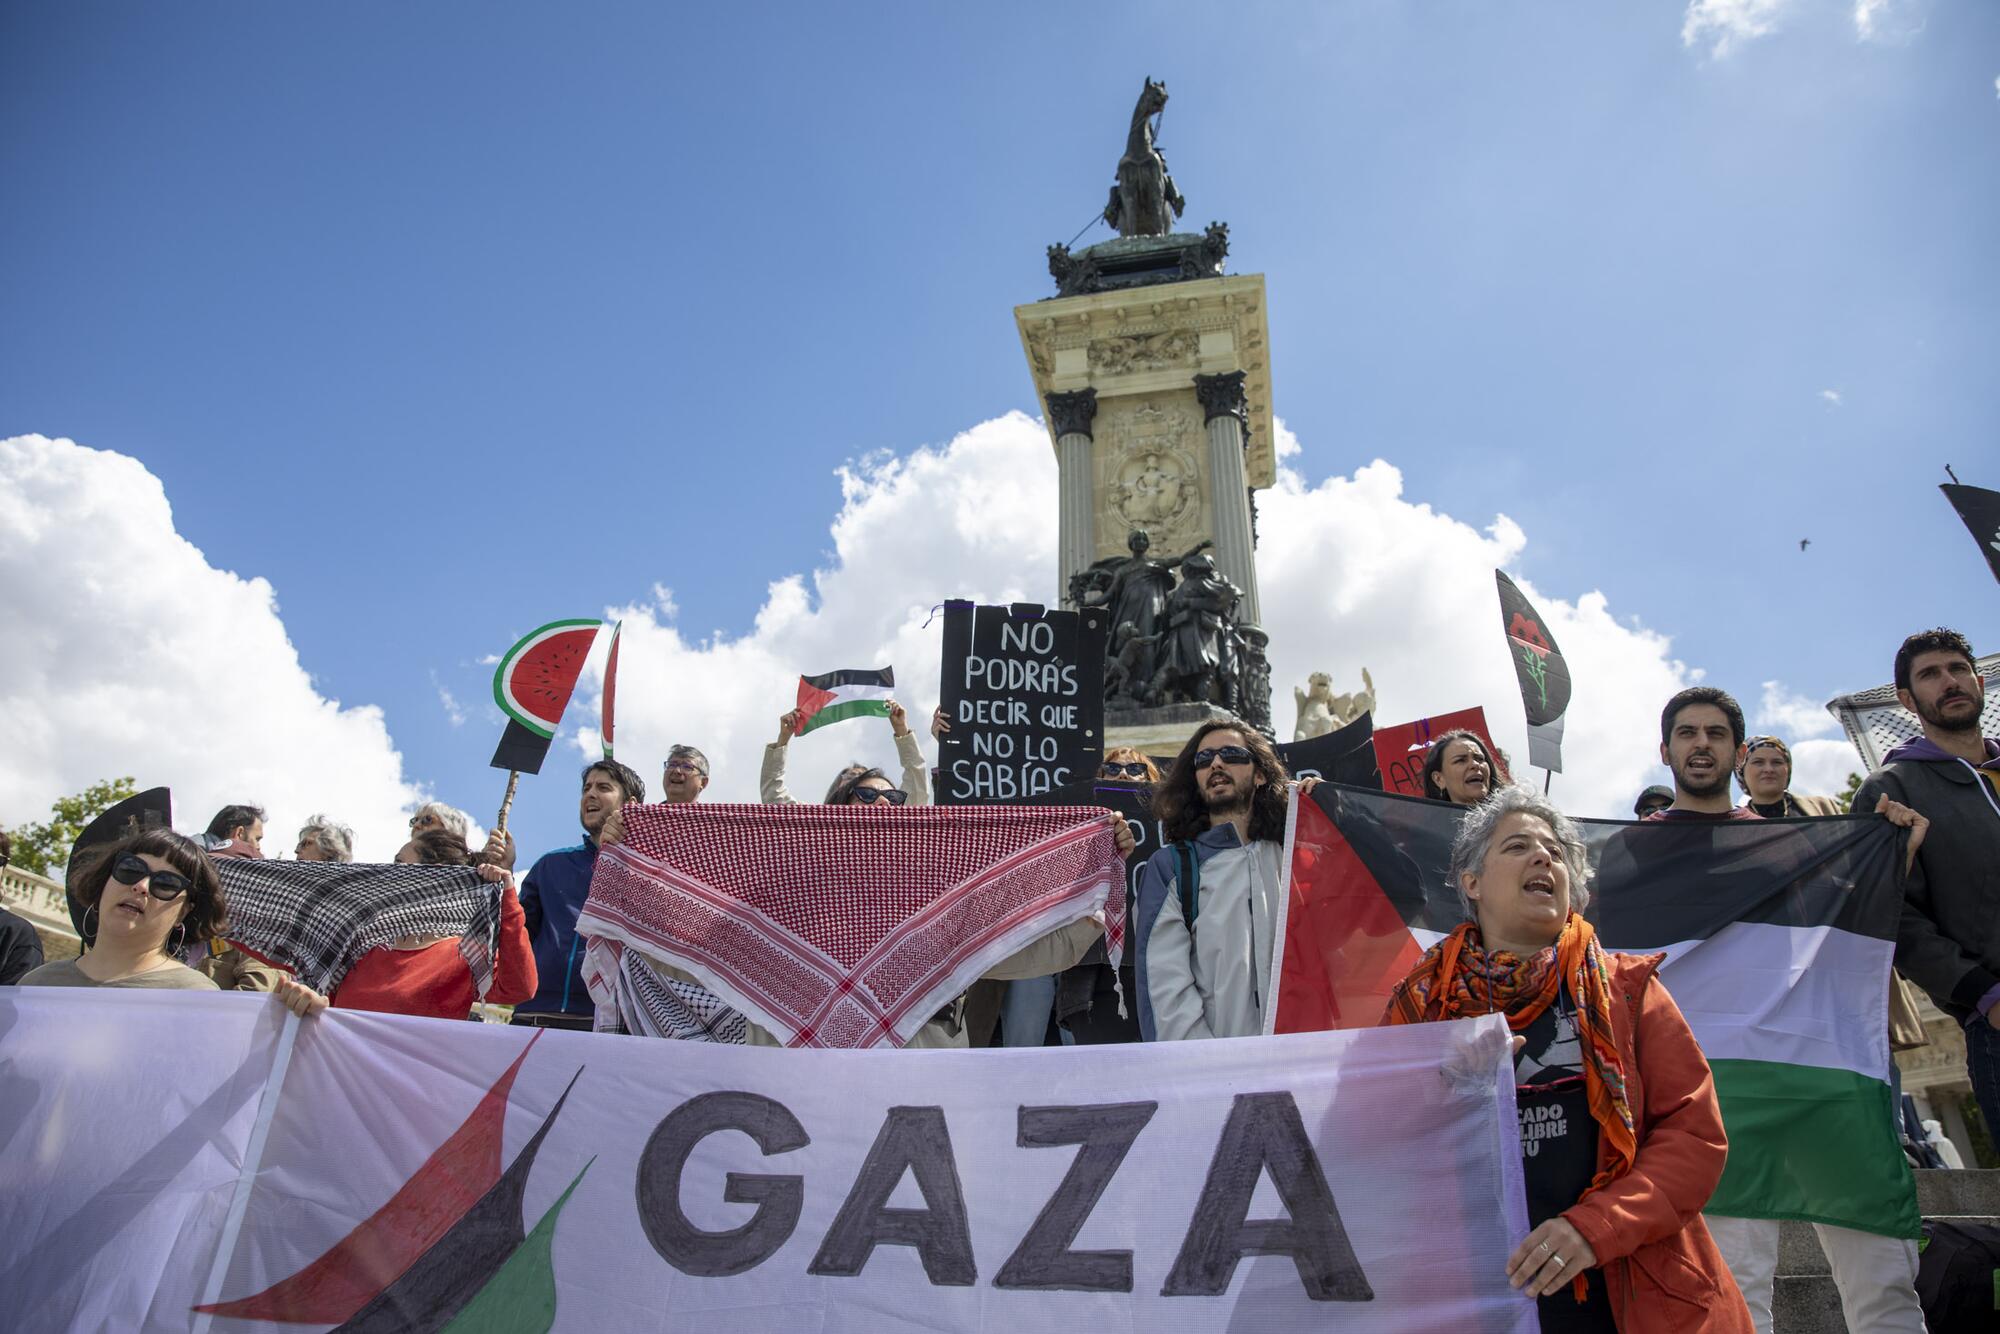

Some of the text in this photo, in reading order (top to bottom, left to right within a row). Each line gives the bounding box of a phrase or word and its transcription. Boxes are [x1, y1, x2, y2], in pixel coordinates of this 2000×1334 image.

[1001, 622, 1054, 655] NO
[965, 656, 1078, 696] PODRÁS
[1040, 705, 1078, 730] QUE
[972, 732, 1058, 762] NO LO
[635, 1090, 1374, 1301] GAZA
